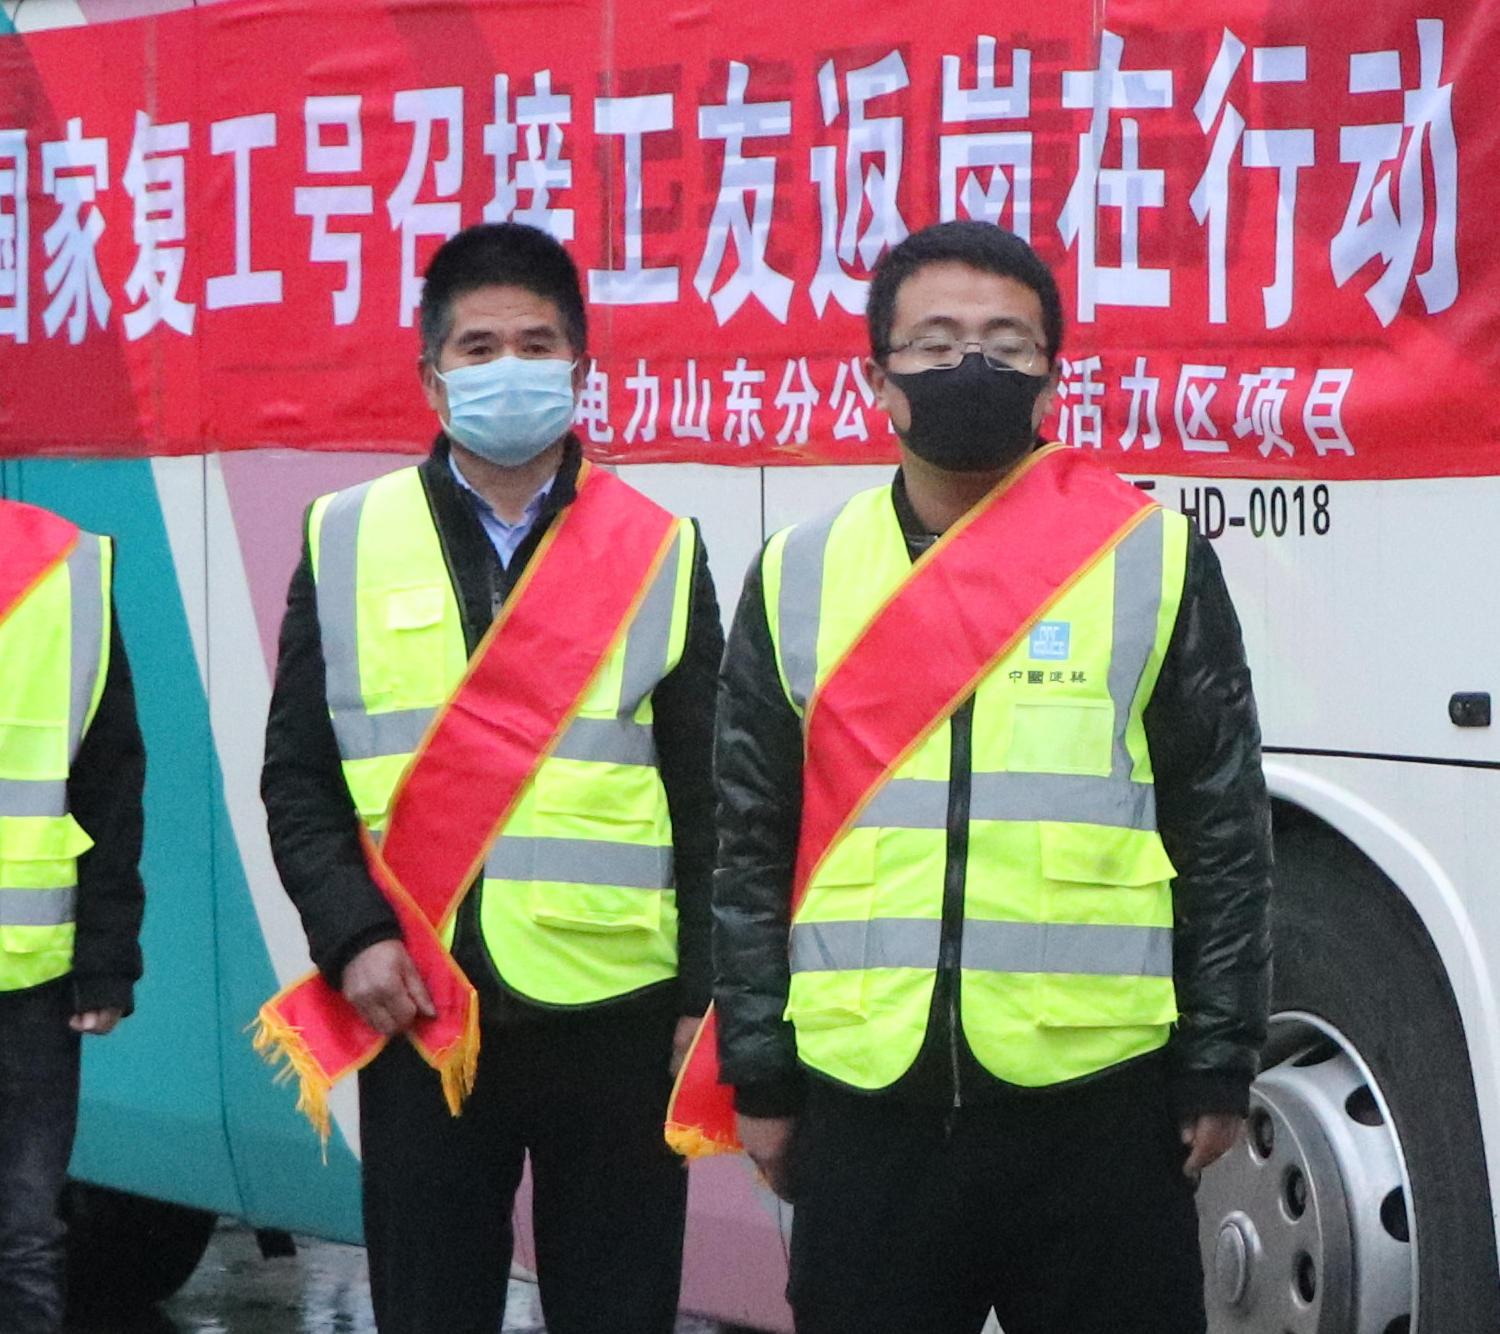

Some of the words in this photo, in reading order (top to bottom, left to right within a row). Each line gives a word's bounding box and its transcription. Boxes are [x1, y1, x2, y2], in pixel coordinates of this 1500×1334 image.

[574, 357, 896, 448] 电力山东分公
